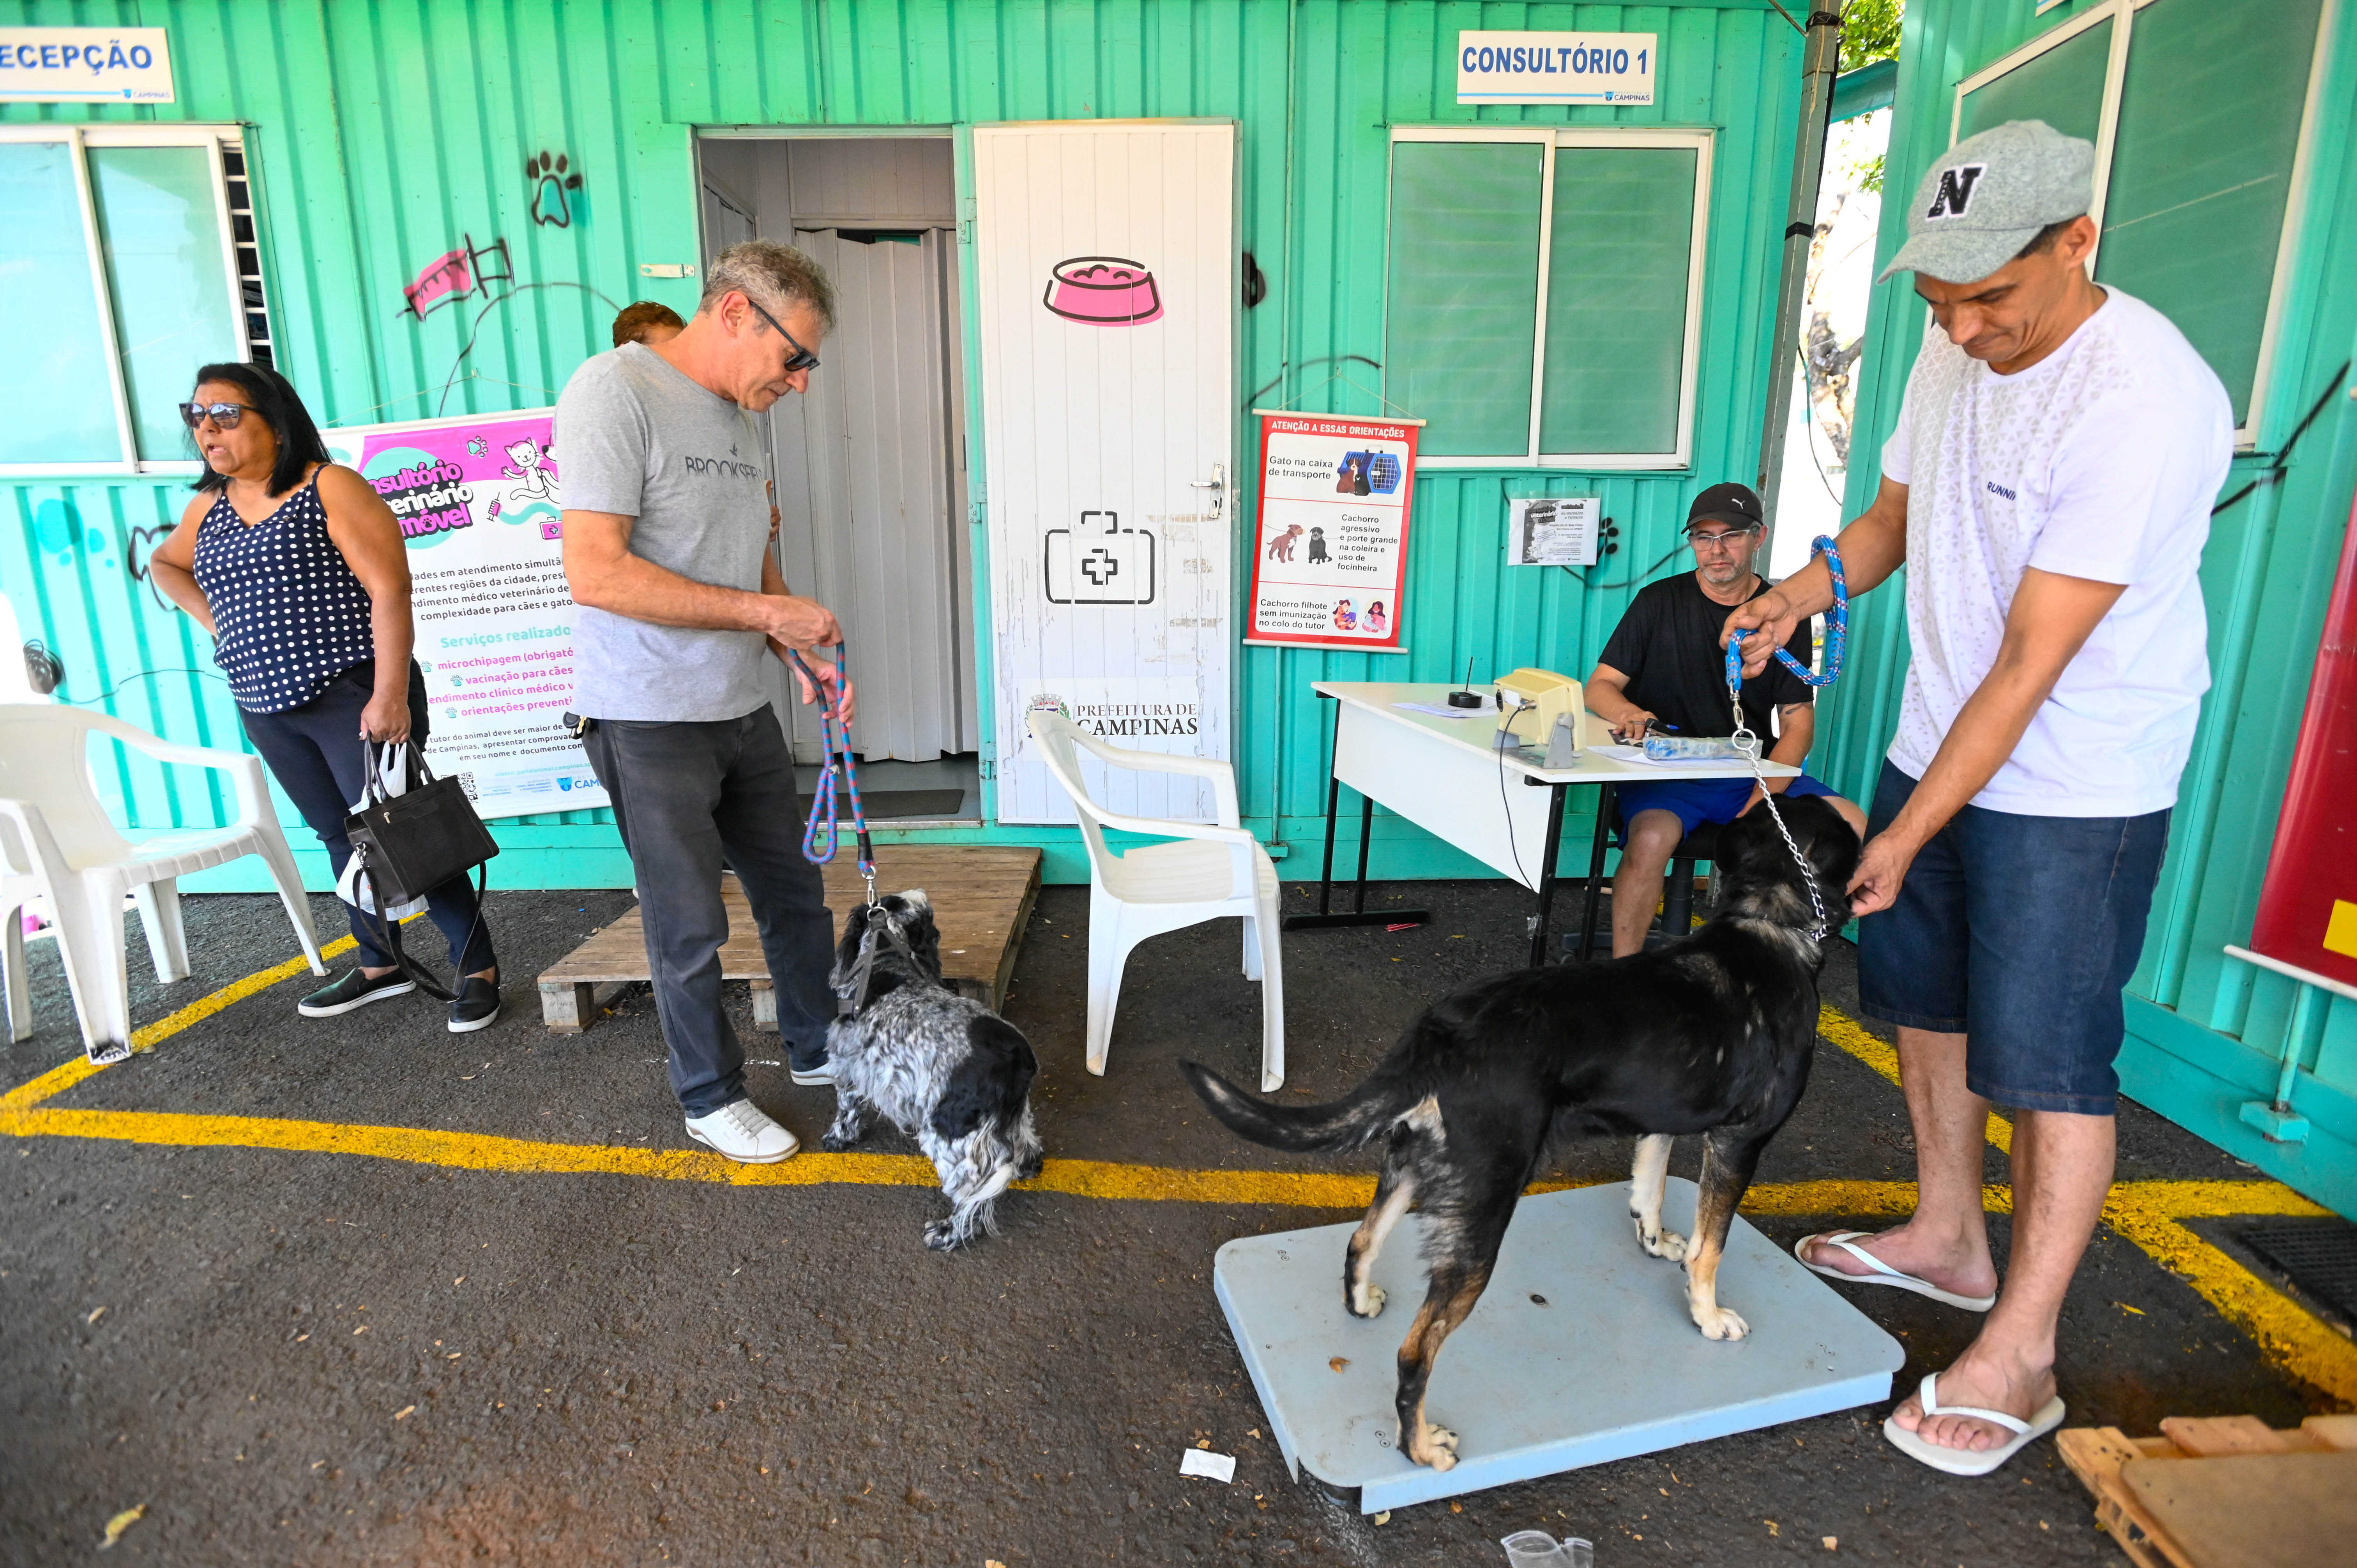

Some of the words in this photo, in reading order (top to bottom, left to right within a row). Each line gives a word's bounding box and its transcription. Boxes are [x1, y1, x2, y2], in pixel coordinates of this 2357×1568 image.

[0, 39, 153, 76] ECEPÇÃO
[1462, 42, 1629, 74] CONSULTÓRIO
[1637, 49, 1647, 74] 1
[1927, 166, 1983, 218] N
[1271, 420, 1309, 432] ATENÇÃO
[1311, 424, 1318, 432] A
[1320, 424, 1346, 434] ESSAS
[1349, 426, 1405, 438] ORIENTAÇÕES
[1270, 456, 1292, 465] Gato
[1309, 458, 1333, 468] caixa
[368, 459, 461, 494] nsultório
[1269, 468, 1280, 476] de
[1283, 468, 1331, 480] transporte
[383, 481, 473, 515] erinário
[398, 502, 471, 537] móvel
[1342, 514, 1379, 523] Cachorro
[458, 563, 522, 576] atendimento
[525, 557, 561, 569] simultâ
[1338, 563, 1377, 571] focinheira
[412, 585, 447, 594] rentes
[450, 580, 487, 591] regiões
[504, 574, 540, 584] cidade,
[461, 592, 498, 603] médico
[500, 586, 555, 599] veterinário
[421, 607, 491, 620] complexidade
[494, 605, 516, 615] para
[518, 602, 540, 610] cães
[550, 599, 575, 609] gato
[1260, 599, 1299, 608] Cachorro
[1302, 601, 1327, 609] filhote
[1279, 610, 1327, 620] imunização
[440, 633, 503, 648] Serviços
[506, 625, 571, 641] realizado
[438, 655, 521, 670] microchipagem
[524, 647, 573, 662] (obrigató
[465, 671, 519, 684] vacinação
[522, 670, 546, 681] para
[549, 666, 573, 676] cães
[429, 691, 486, 704] endimento
[489, 687, 523, 698] clínico
[526, 683, 565, 694] médico
[461, 703, 525, 716] orientações
[527, 696, 572, 712] preventi
[1077, 704, 1172, 716] PREFEITURA
[1176, 703, 1197, 715] DE
[465, 731, 491, 740] animal
[528, 725, 551, 733] maior
[1078, 717, 1198, 736] CAMPINAS
[439, 744, 480, 752] Campinas,
[483, 739, 526, 749] apresentar
[520, 745, 566, 755] documento
[517, 762, 592, 775] portalanimal.campinas.sp
[574, 779, 601, 789] CAM
